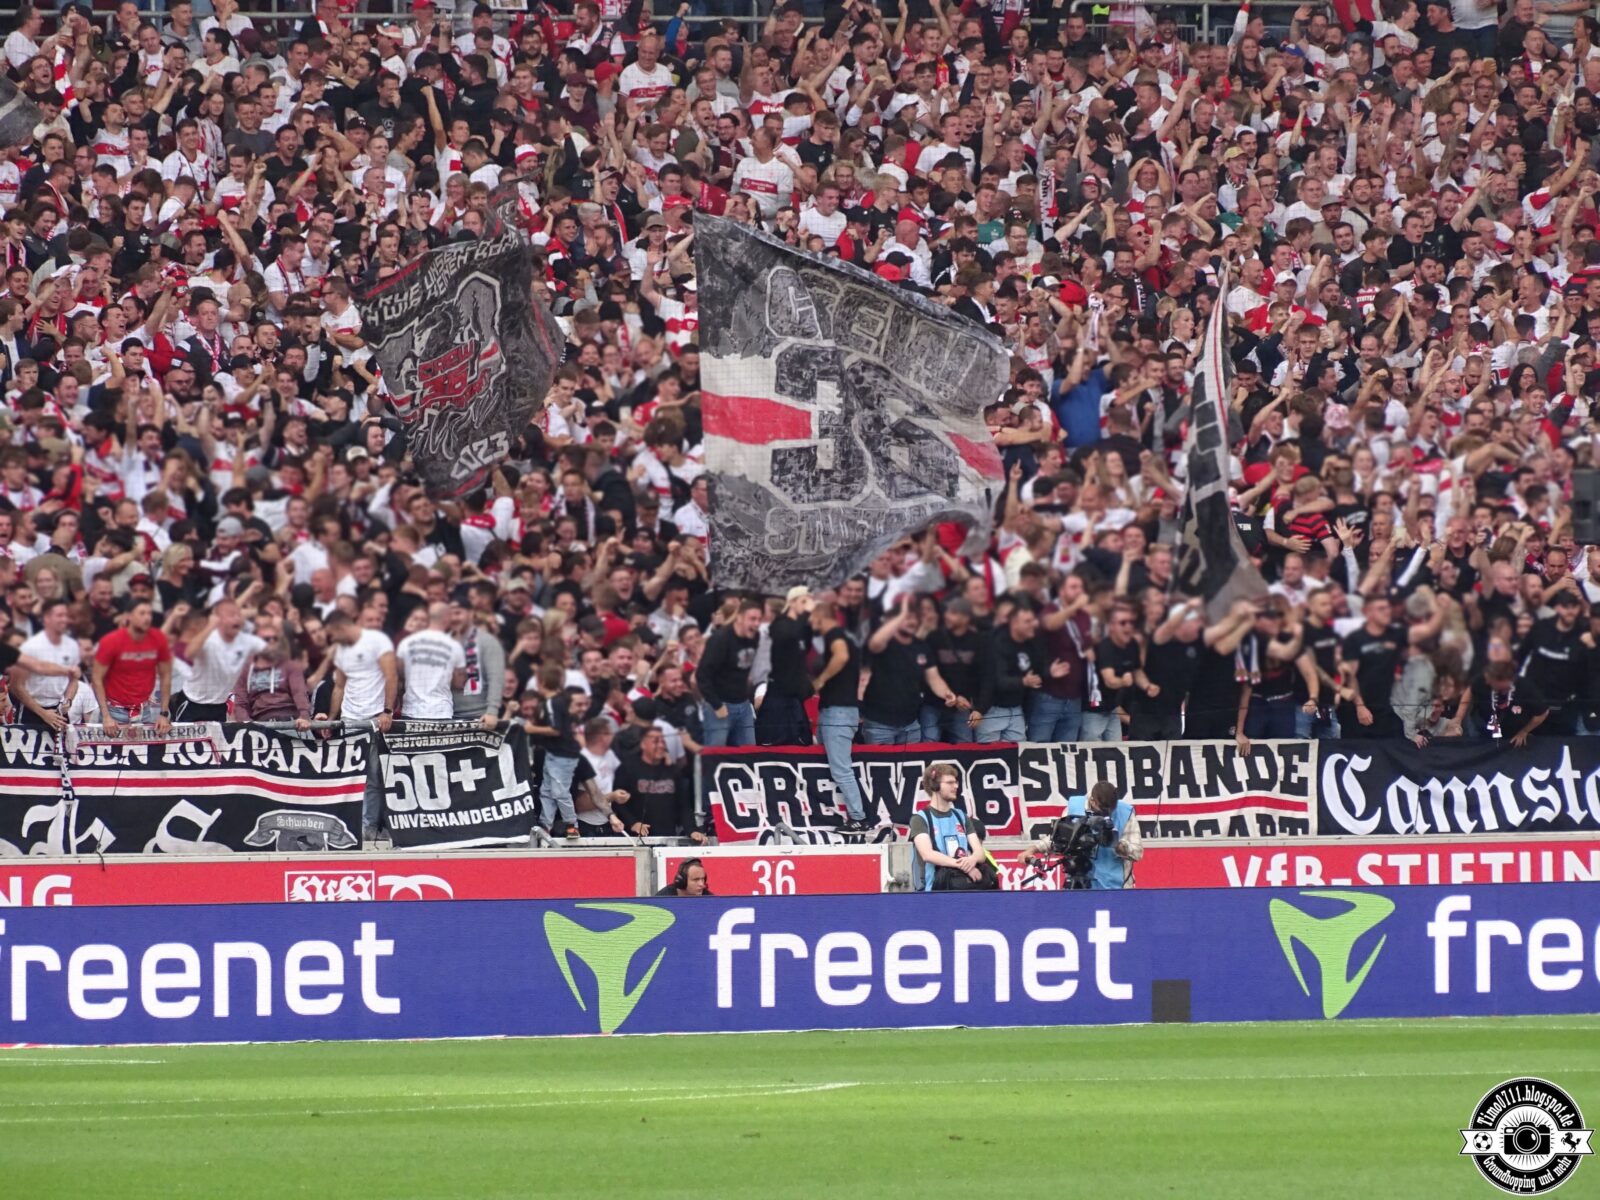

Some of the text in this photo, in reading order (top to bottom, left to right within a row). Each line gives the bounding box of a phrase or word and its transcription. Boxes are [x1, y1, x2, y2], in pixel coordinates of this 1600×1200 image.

[142, 724, 207, 740] INERNO
[380, 744, 531, 813] 50+1
[1019, 743, 1310, 801] SÜDBANDE
[276, 815, 325, 830] Schwaben
[388, 795, 534, 830] UNVERHANDELBAR
[752, 860, 796, 895] 36
[0, 919, 400, 1021] reenet
[709, 907, 1133, 1008] freenet
[1427, 895, 1600, 994] fre
